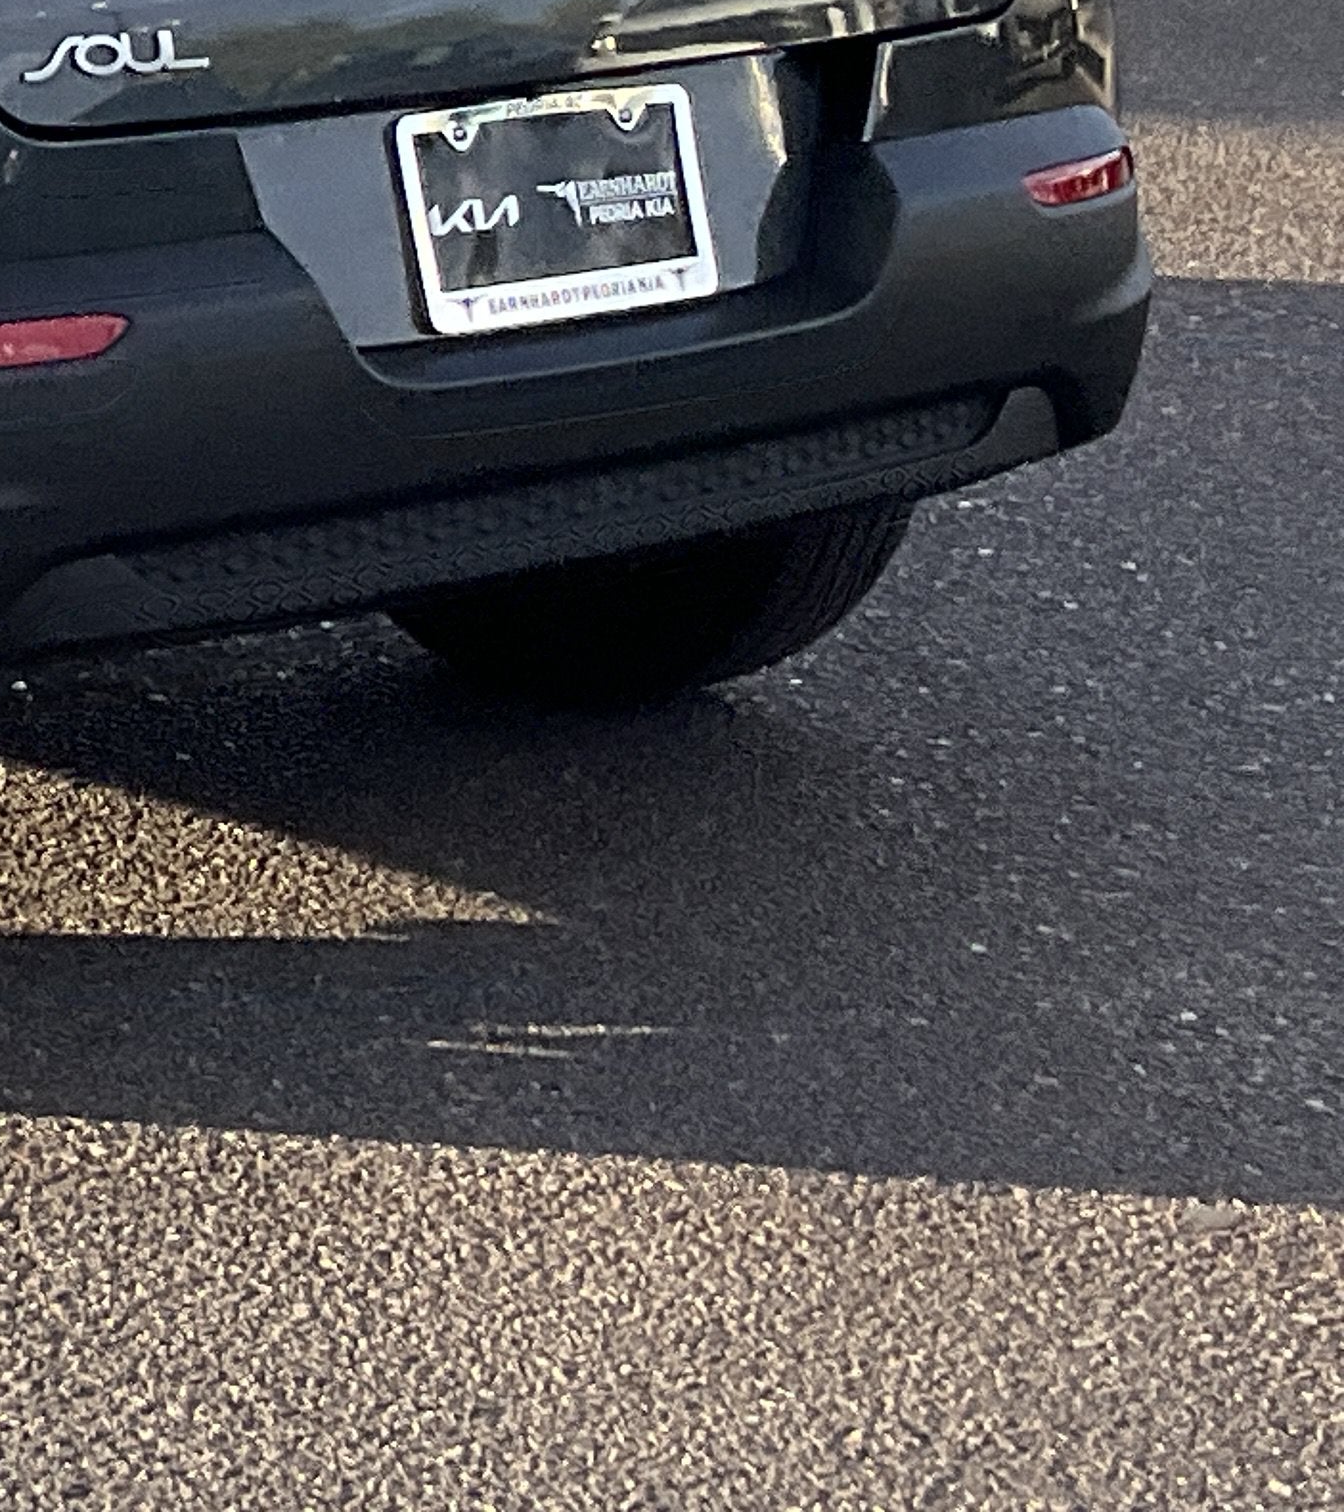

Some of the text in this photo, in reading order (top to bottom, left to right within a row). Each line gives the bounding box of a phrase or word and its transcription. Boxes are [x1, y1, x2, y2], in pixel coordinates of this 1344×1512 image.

[20, 29, 210, 82] SOUL
[577, 170, 676, 199] EARNHARDT
[428, 194, 520, 236] KIA
[589, 196, 675, 225] PEORIA KIA
